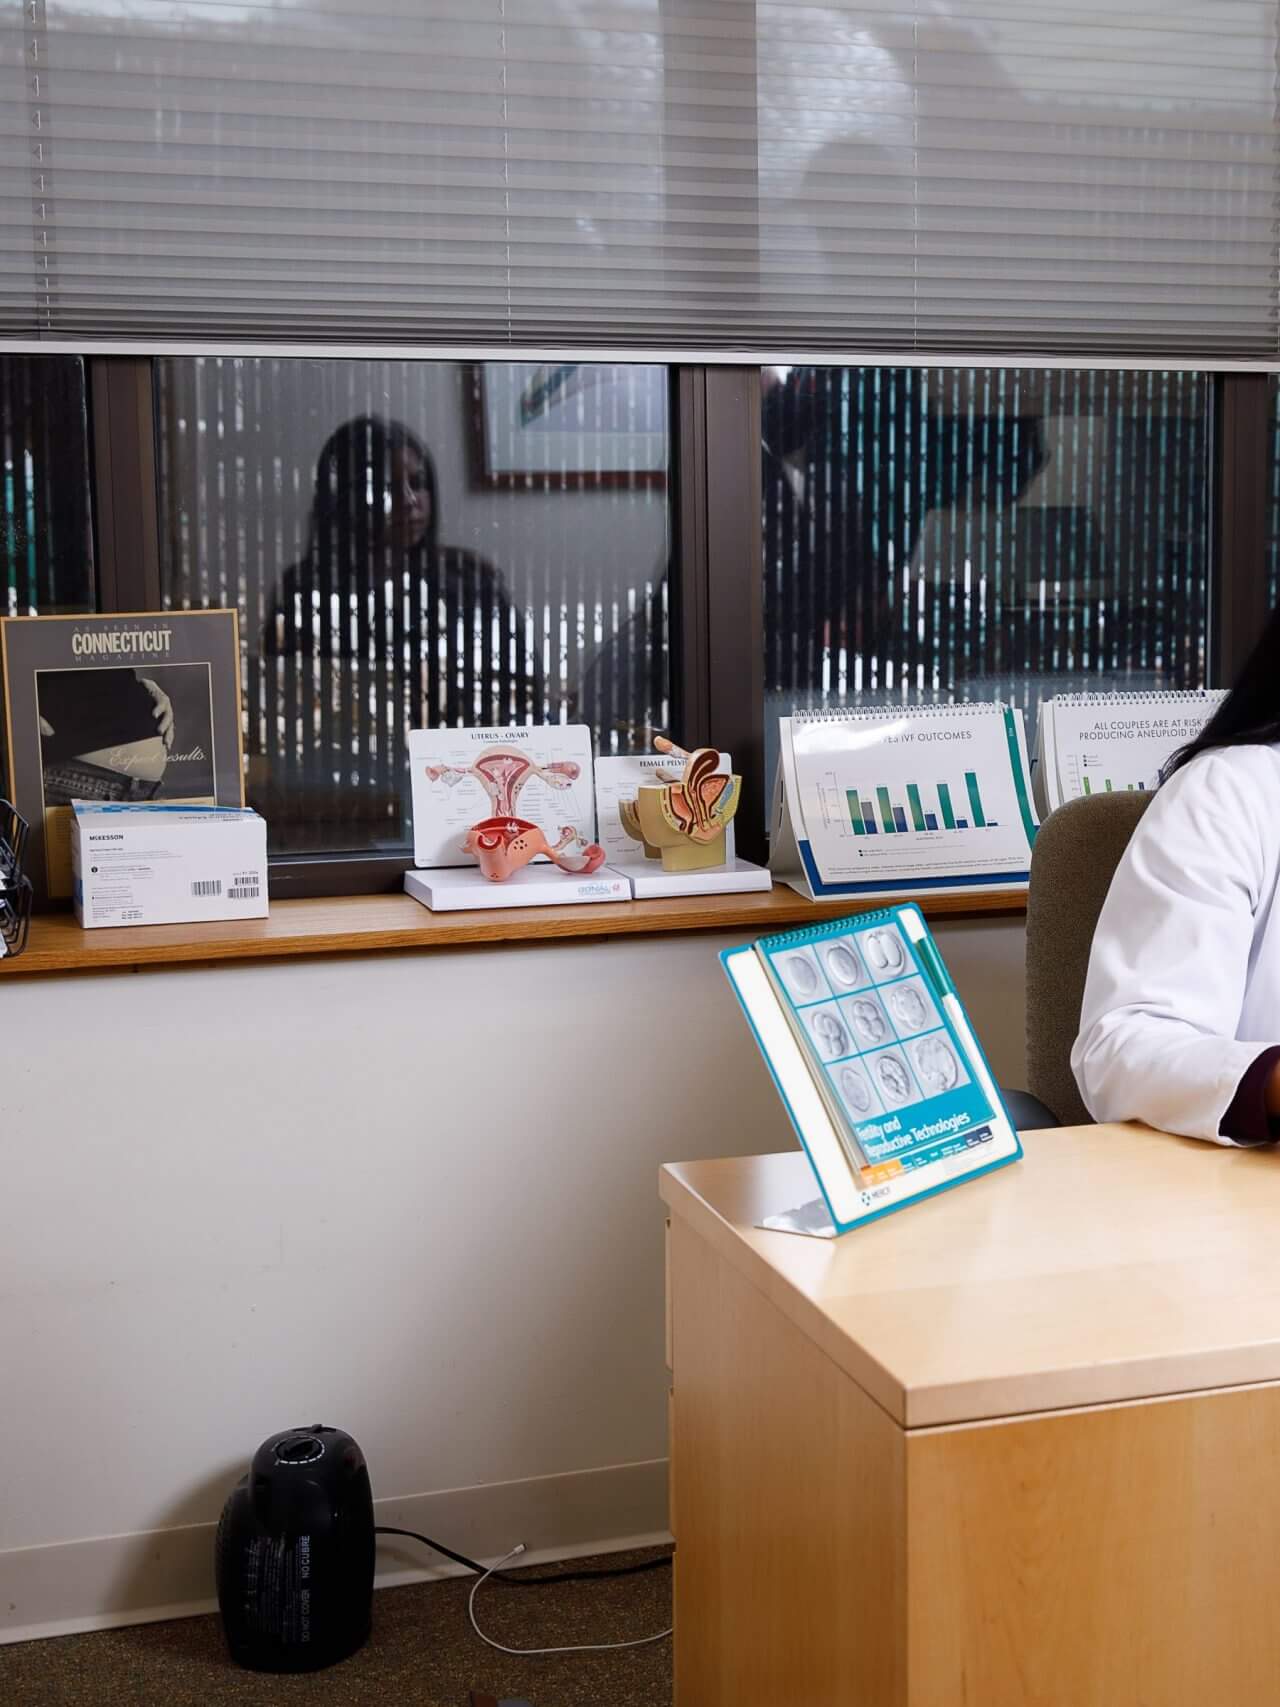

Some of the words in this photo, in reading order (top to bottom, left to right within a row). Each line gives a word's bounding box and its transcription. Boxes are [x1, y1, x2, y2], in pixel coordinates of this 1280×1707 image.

[72, 630, 172, 655] CONNECTICUT
[1094, 722, 1108, 730] ALL
[1111, 720, 1150, 730] COUPLES
[1153, 719, 1169, 729] ARE
[1171, 719, 1181, 728] AT
[1184, 718, 1202, 728] RISK
[917, 730, 972, 742] OUTCOMES
[1079, 730, 1135, 741] PRODUCING
[1137, 728, 1187, 739] ANEUPLOID
[883, 1115, 902, 1134] and
[909, 1111, 971, 1143] Technologies
[301, 1535, 311, 1565] CUBRE
